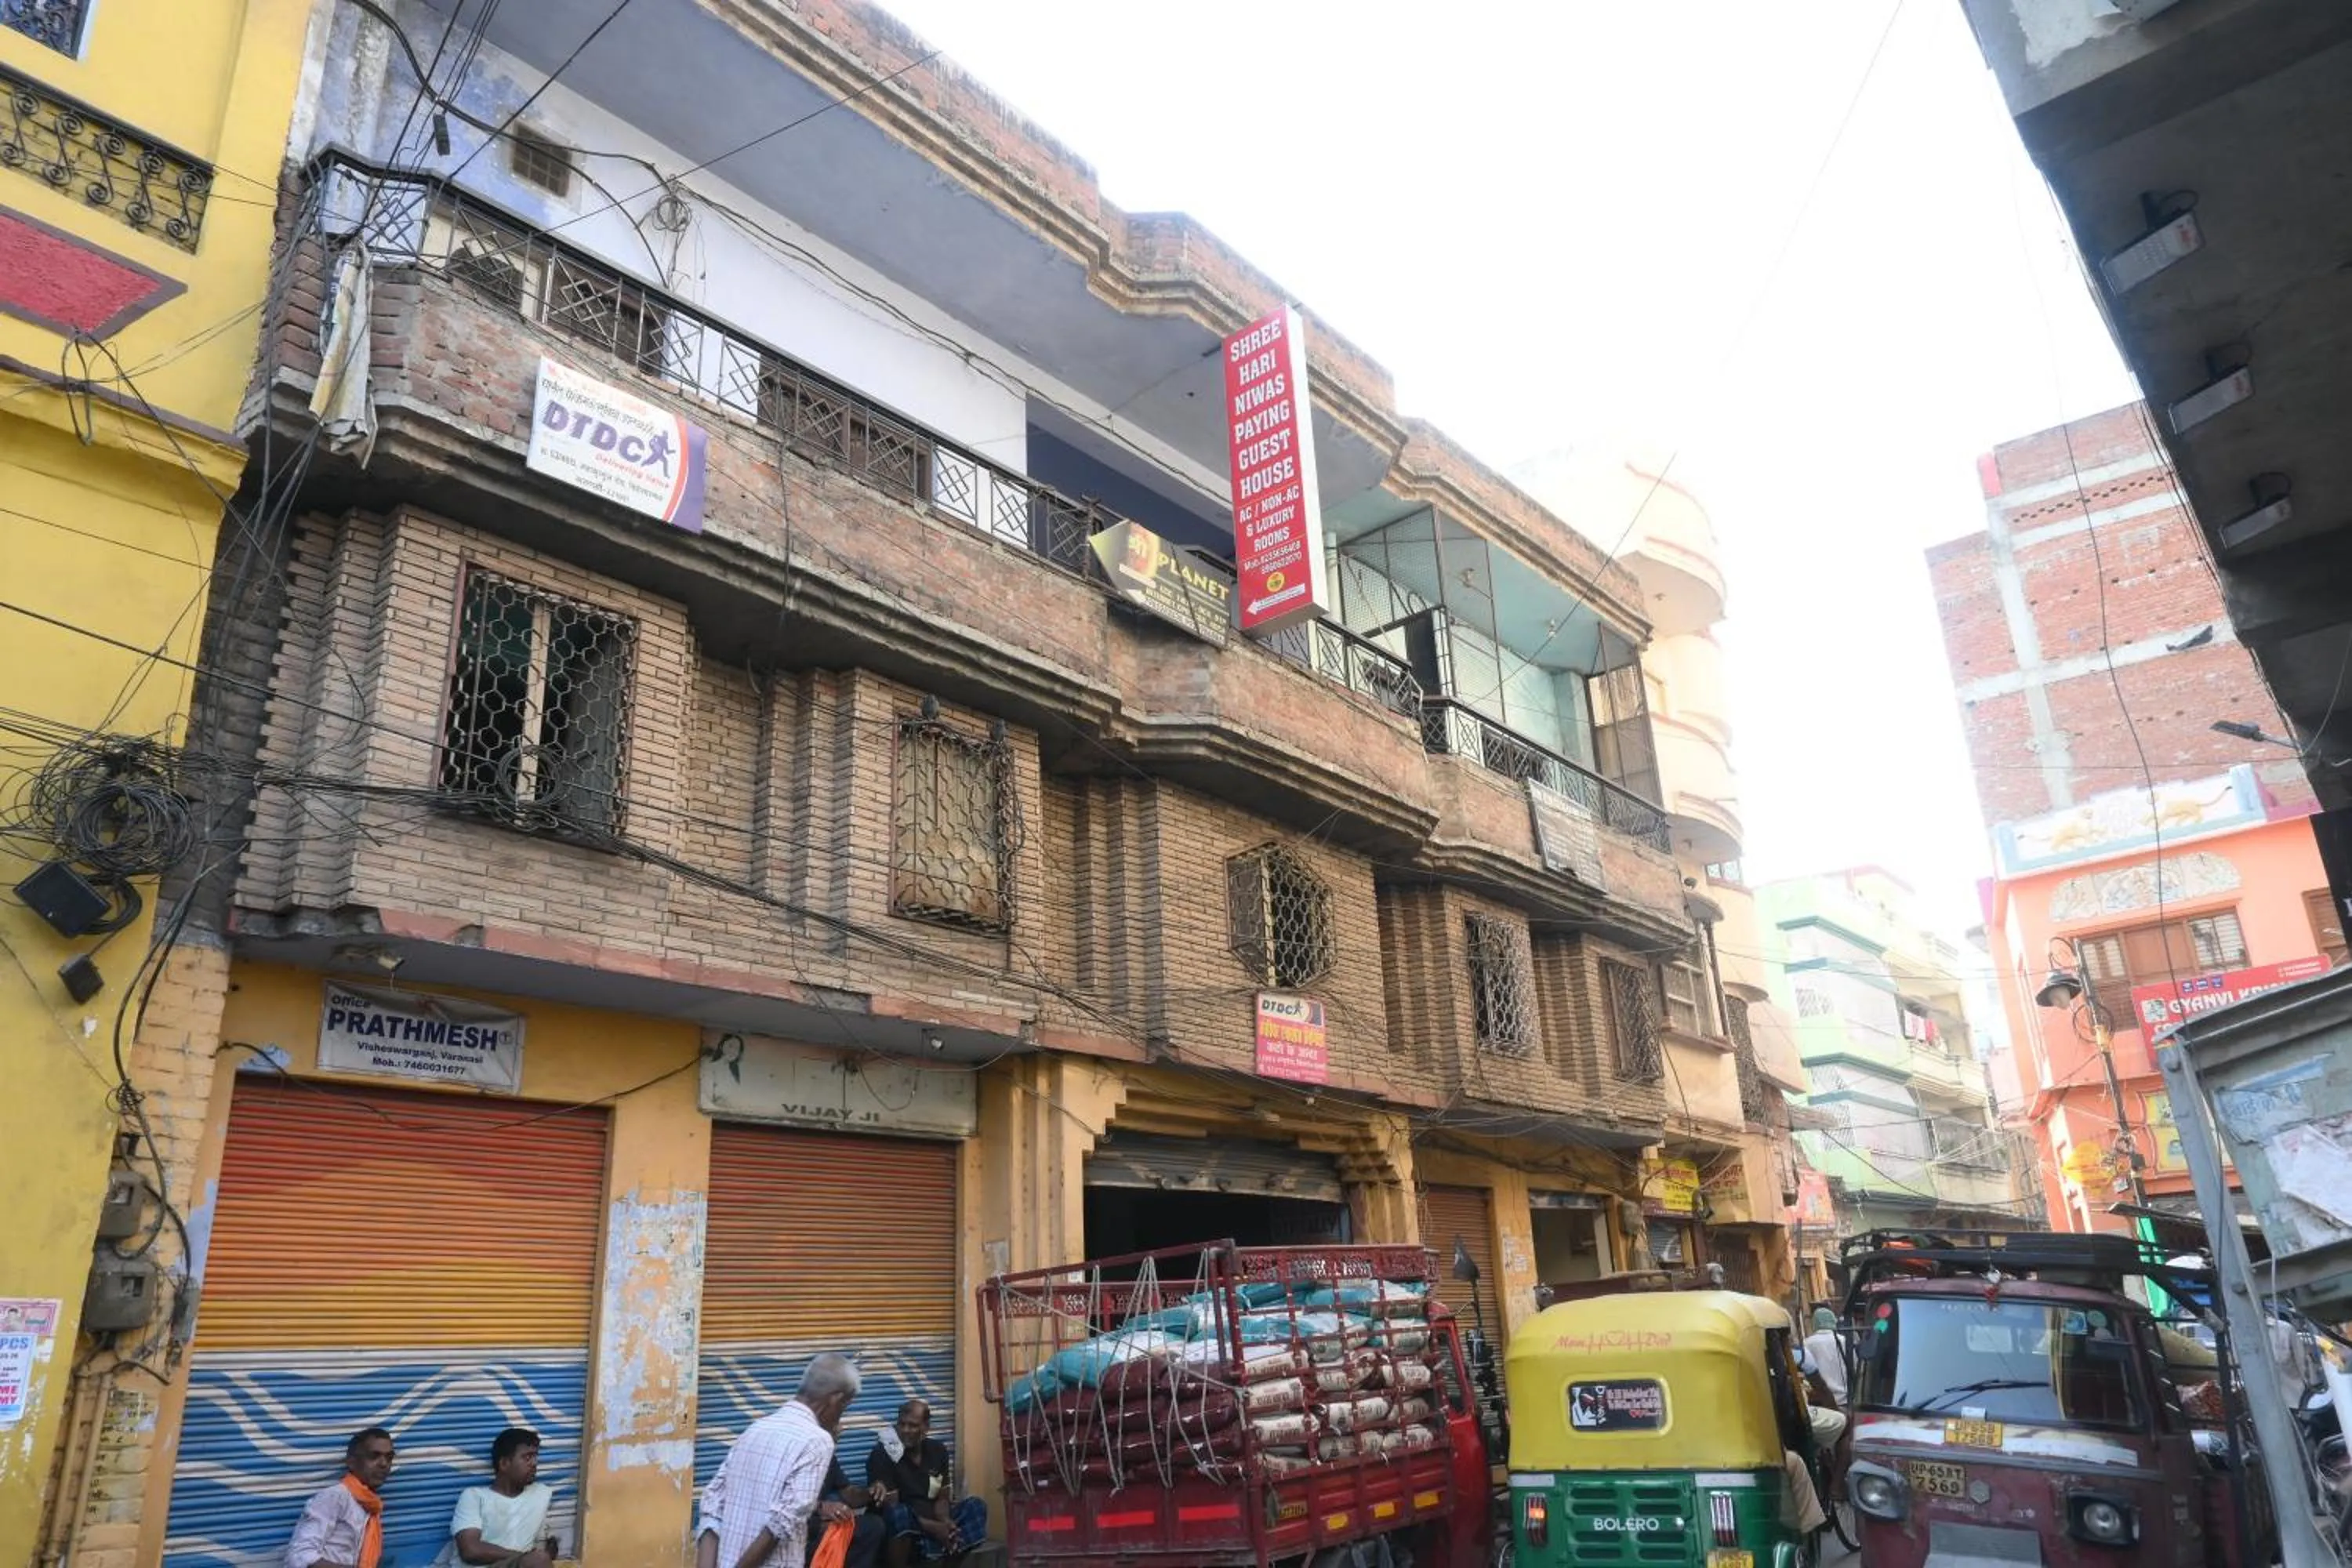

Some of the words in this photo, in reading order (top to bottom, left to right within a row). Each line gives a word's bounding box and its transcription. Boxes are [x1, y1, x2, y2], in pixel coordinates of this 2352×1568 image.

[1231, 319, 1282, 362] SHREE
[1240, 348, 1276, 386] HARI
[1235, 372, 1285, 416] NIWAS
[541, 400, 645, 463] DTDC
[1235, 399, 1290, 444] PAYING
[1239, 428, 1290, 470] GUEST
[1240, 456, 1294, 499] HOUSE
[1240, 506, 1252, 524] AC
[1261, 485, 1299, 514] NON-AC
[1255, 506, 1295, 532] LUXURY
[1254, 526, 1290, 553] ROOMS
[1157, 552, 1229, 601] PLANET
[332, 995, 372, 1008] Office
[2168, 990, 2234, 1014] GYANVI
[327, 1007, 499, 1052] PRATHMESH
[441, 1051, 484, 1064] Varanasi
[781, 1103, 853, 1120] VIJAY
[858, 1112, 880, 1122] JI
[1593, 1518, 1659, 1531] BOLERO
